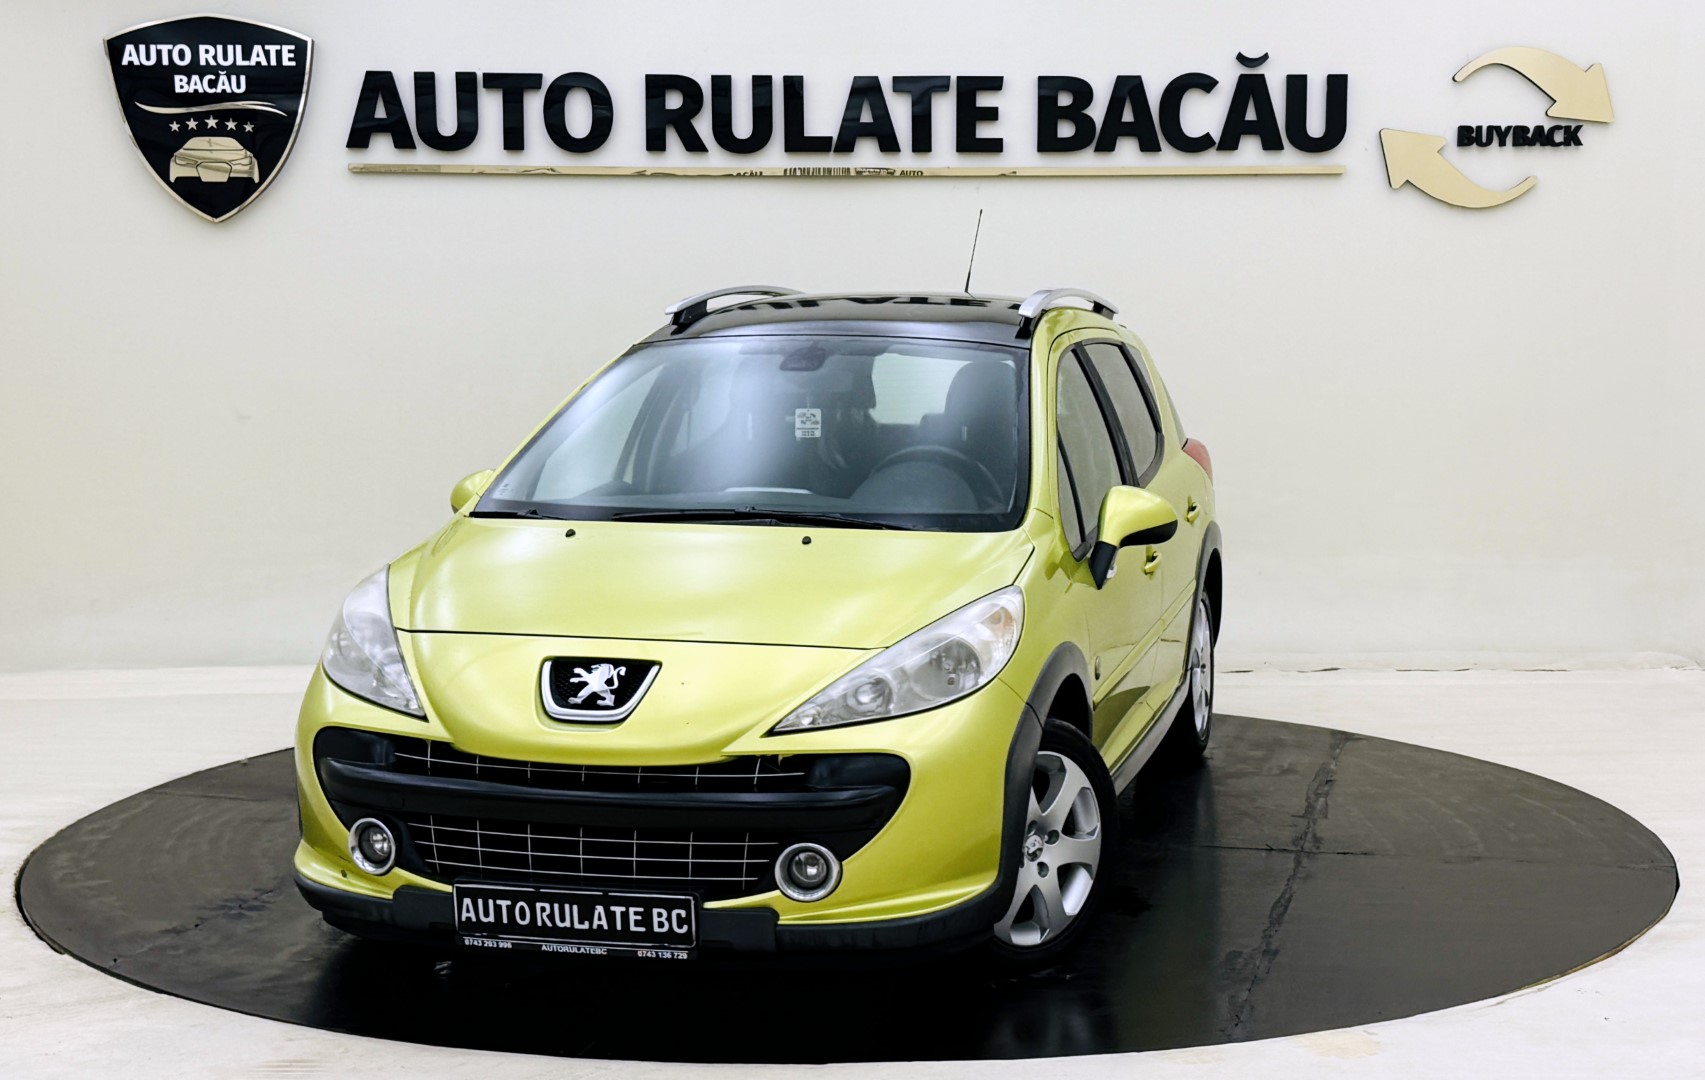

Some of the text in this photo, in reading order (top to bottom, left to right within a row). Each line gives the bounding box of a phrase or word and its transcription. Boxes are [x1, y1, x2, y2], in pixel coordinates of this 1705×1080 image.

[121, 44, 297, 67] AUTO RULATE
[173, 70, 247, 93] BACĂU
[346, 52, 1349, 155] AUTO RULATE BACĂU
[1457, 125, 1584, 147] BUYBACK
[461, 897, 689, 934] AUTO RULATE BC
[541, 944, 608, 955] AUTORULATEBC
[637, 950, 656, 958] 0743
